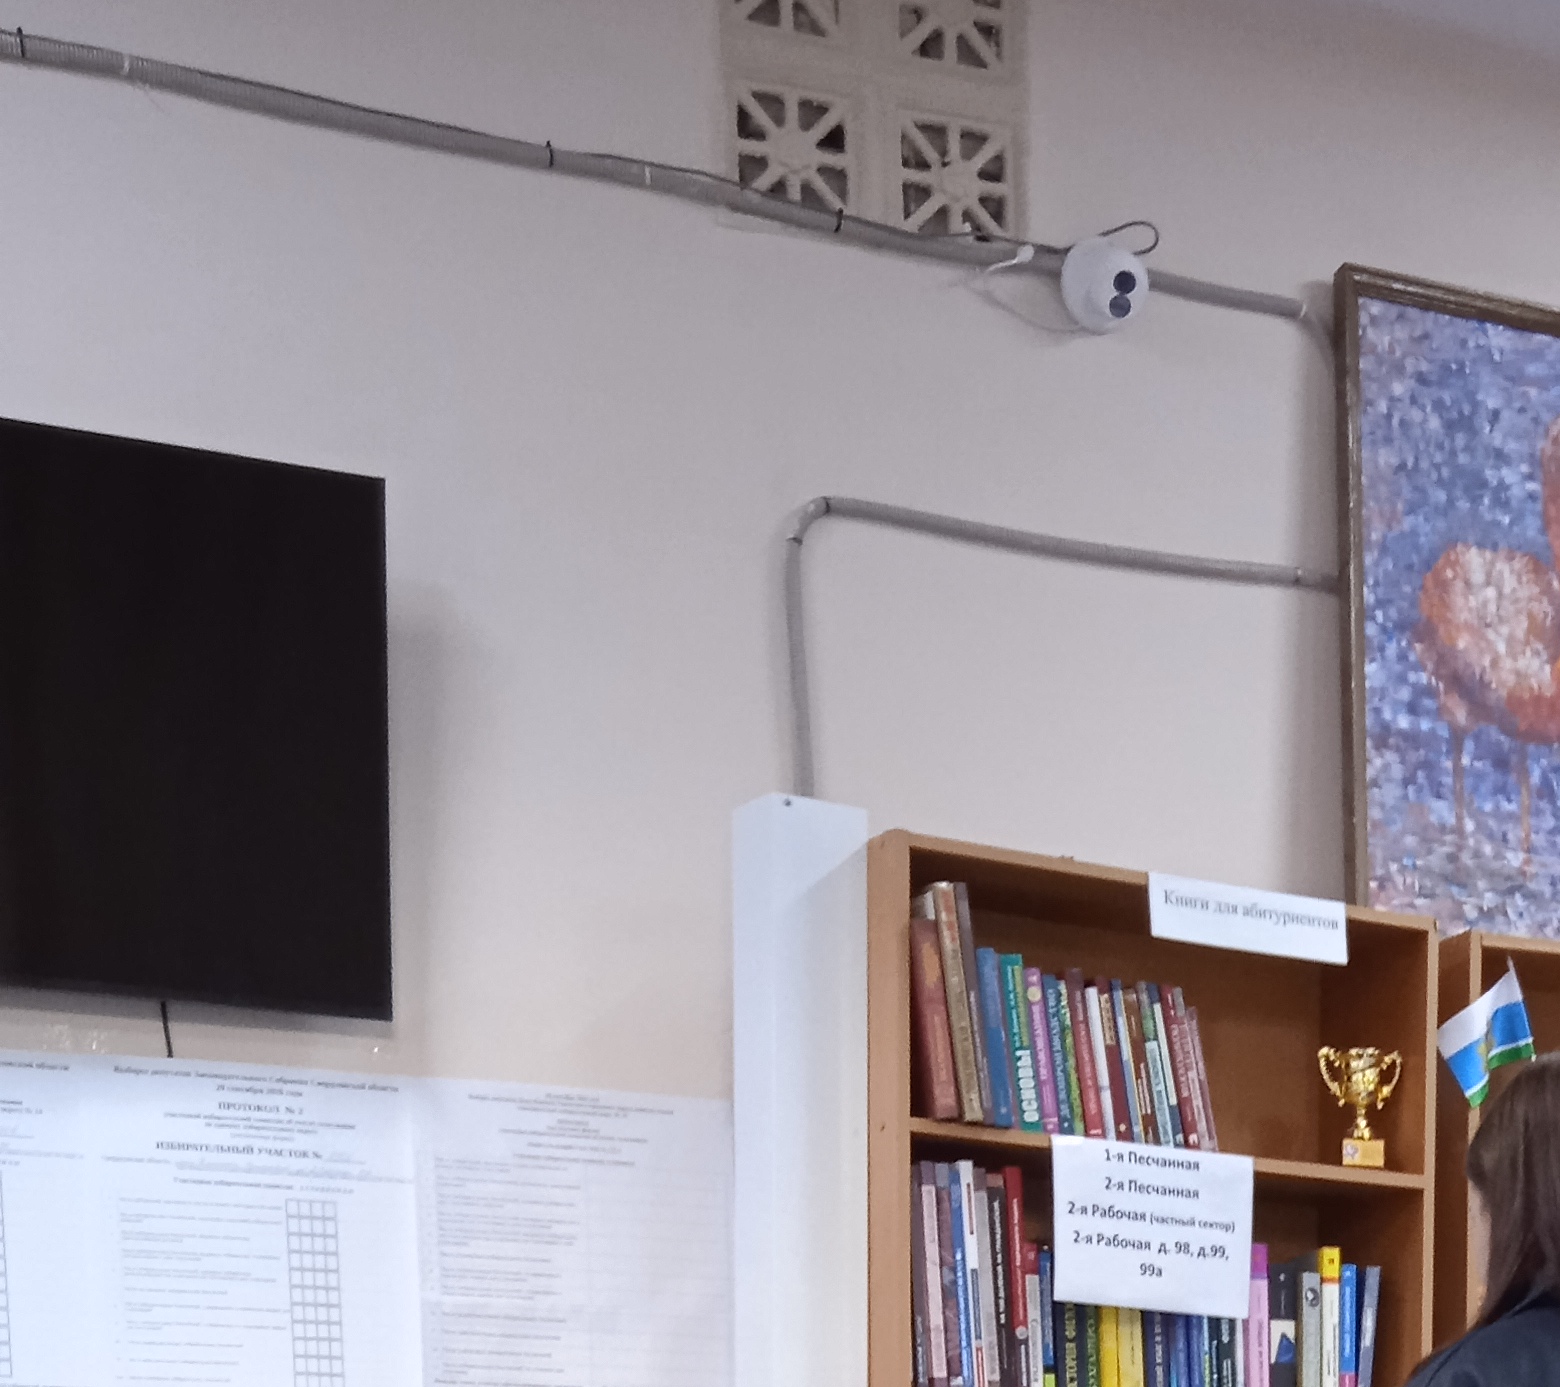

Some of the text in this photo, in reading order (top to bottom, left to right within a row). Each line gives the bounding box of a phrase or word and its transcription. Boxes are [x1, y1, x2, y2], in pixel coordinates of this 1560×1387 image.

[1163, 888, 1339, 930] Книги для абитуриентов
[1015, 1049, 1040, 1123] ОСНОВЫ
[1104, 1149, 1200, 1172] 1-я Песчанная
[1104, 1177, 1200, 1199] 2-я Песчанная
[1067, 1201, 1236, 1234] 2-я Рабочая (частный сектор)
[1073, 1230, 1093, 1245] 2-я
[1096, 1233, 1151, 1251] Рабочая
[1157, 1241, 1170, 1255] д.
[1174, 1240, 1194, 1258] 98,
[1139, 1263, 1163, 1278] 99а
